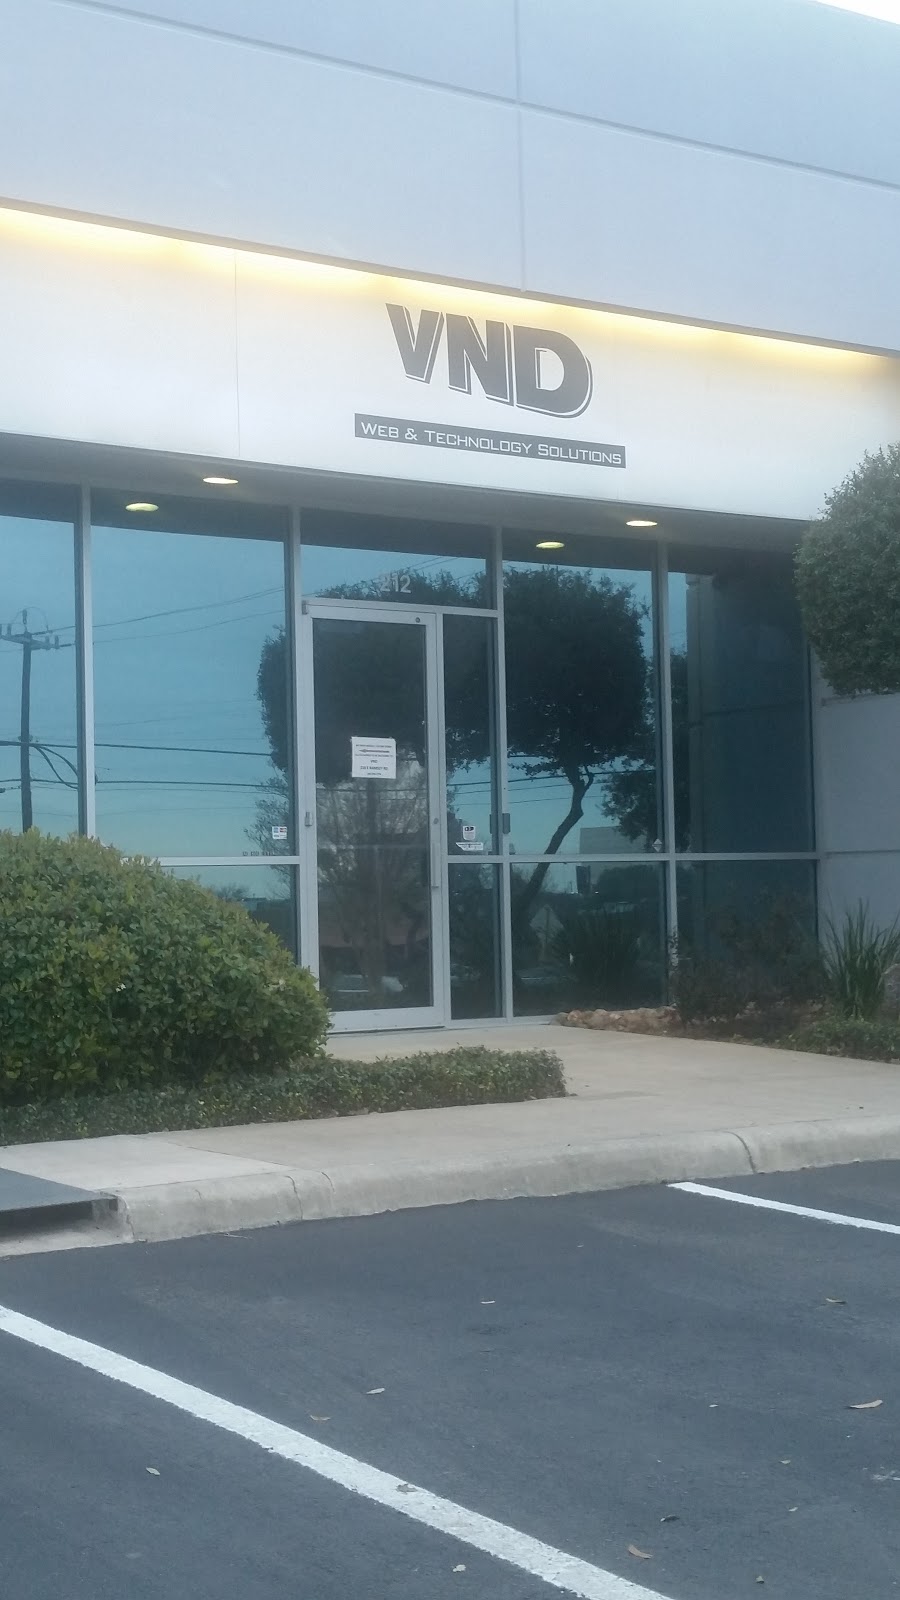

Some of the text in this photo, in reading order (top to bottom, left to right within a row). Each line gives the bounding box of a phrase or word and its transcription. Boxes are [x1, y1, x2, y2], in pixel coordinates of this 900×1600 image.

[386, 303, 593, 418] VND
[361, 422, 621, 464] WEB & TECHNOLOGY SOLUTIONS
[380, 574, 411, 593] 212
